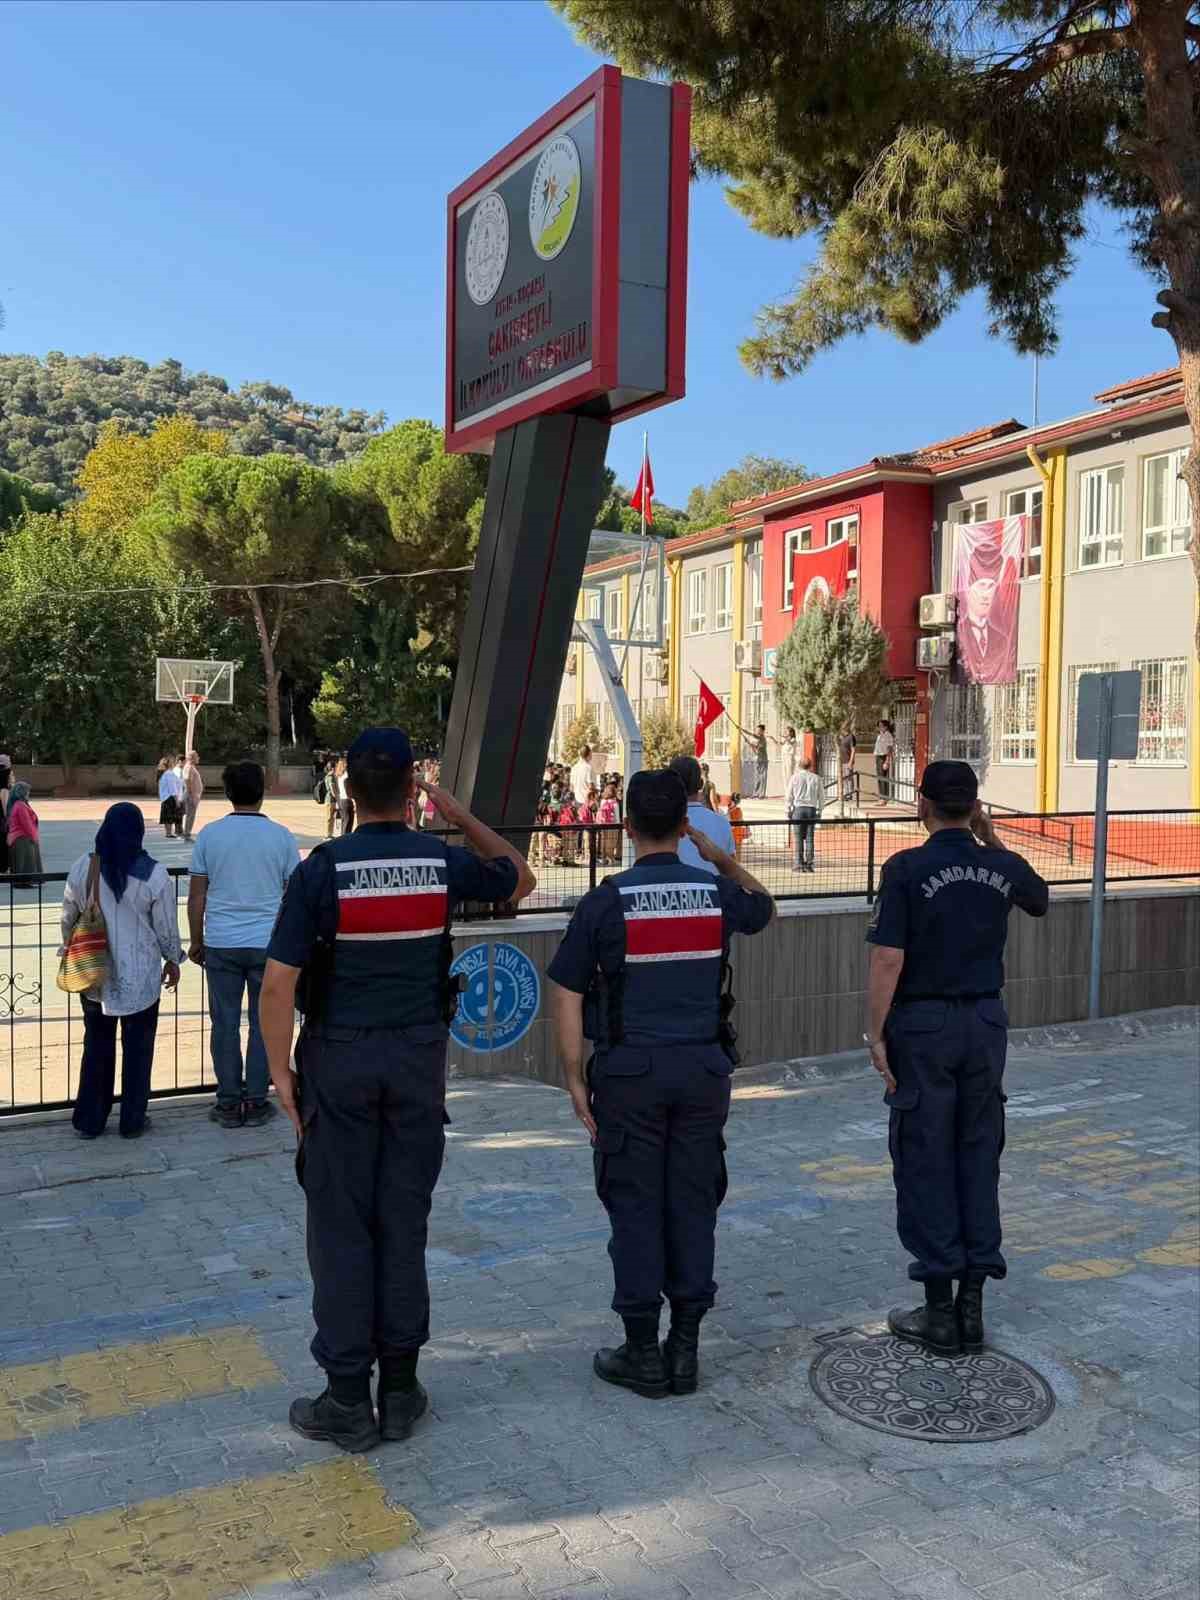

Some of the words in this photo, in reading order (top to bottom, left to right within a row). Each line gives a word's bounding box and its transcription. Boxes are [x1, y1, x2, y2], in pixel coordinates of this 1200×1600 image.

[350, 866, 440, 890] JANDARMA
[921, 866, 1013, 898] JANDARMA
[631, 890, 714, 912] JANDARMA
